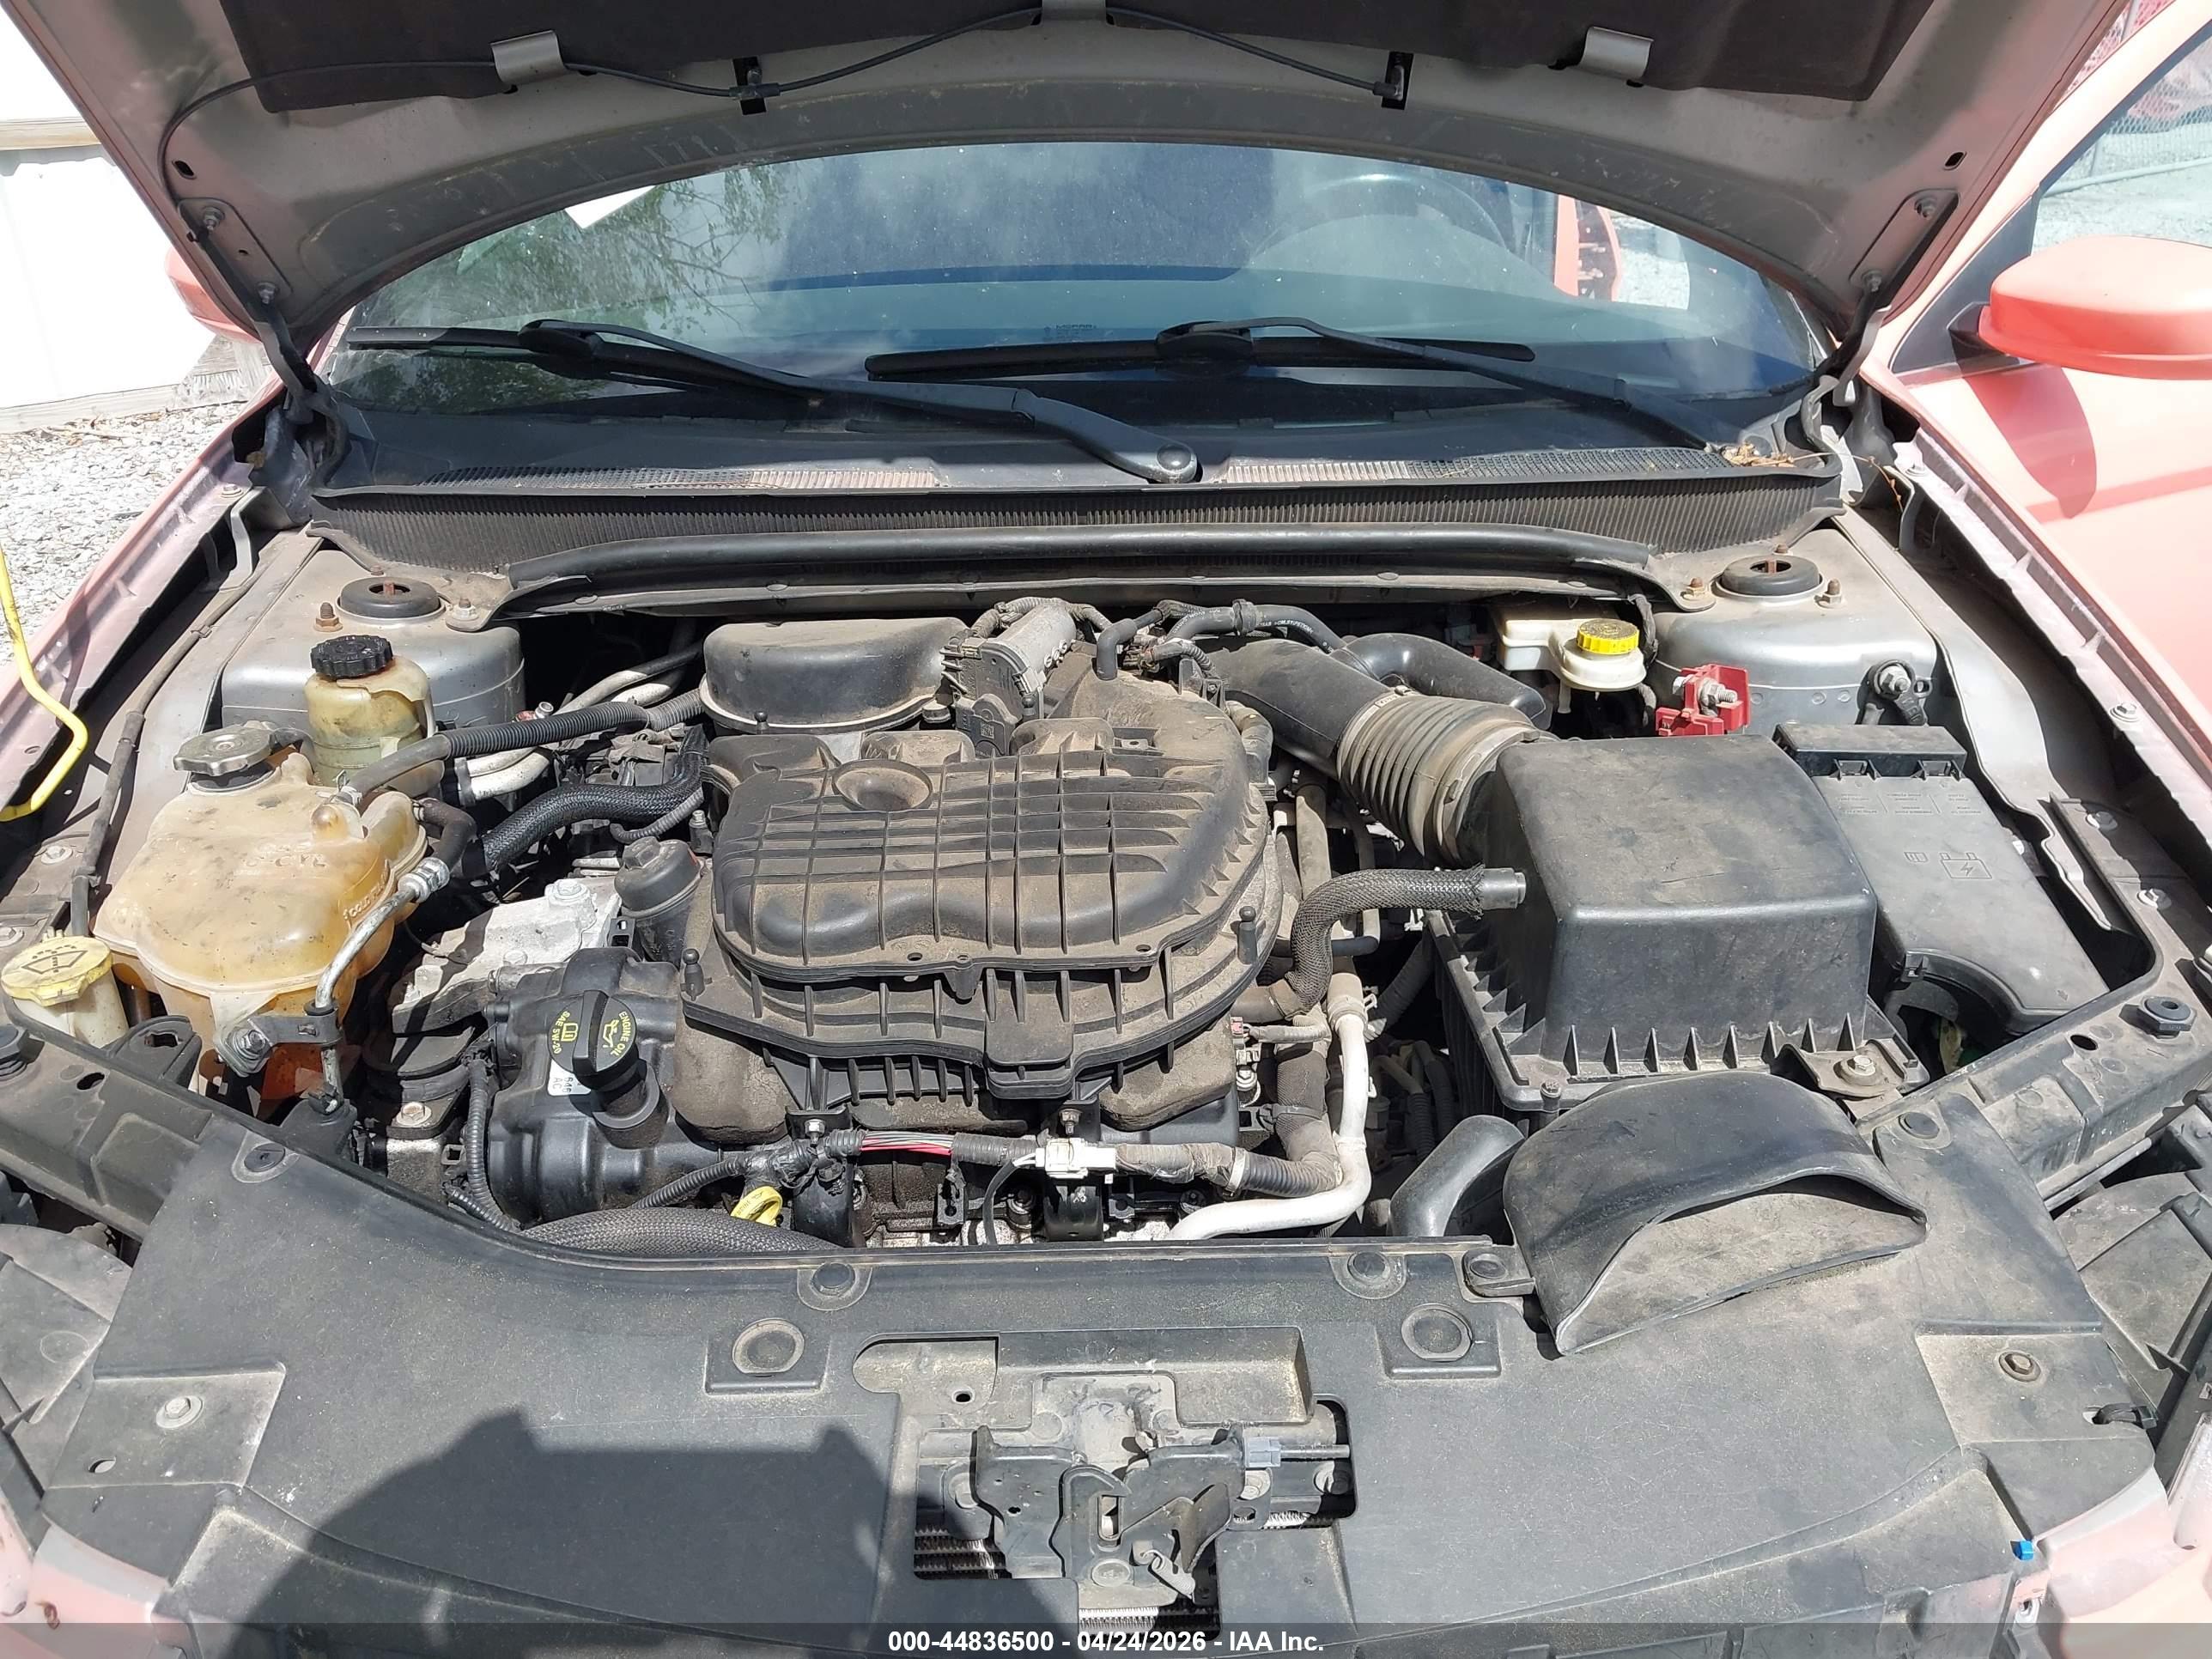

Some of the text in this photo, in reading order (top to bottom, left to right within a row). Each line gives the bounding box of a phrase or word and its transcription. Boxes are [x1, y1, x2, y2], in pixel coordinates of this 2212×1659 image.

[551, 1011, 571, 1054] SAE 5W-20
[611, 1011, 632, 1056] ENGINE OIL
